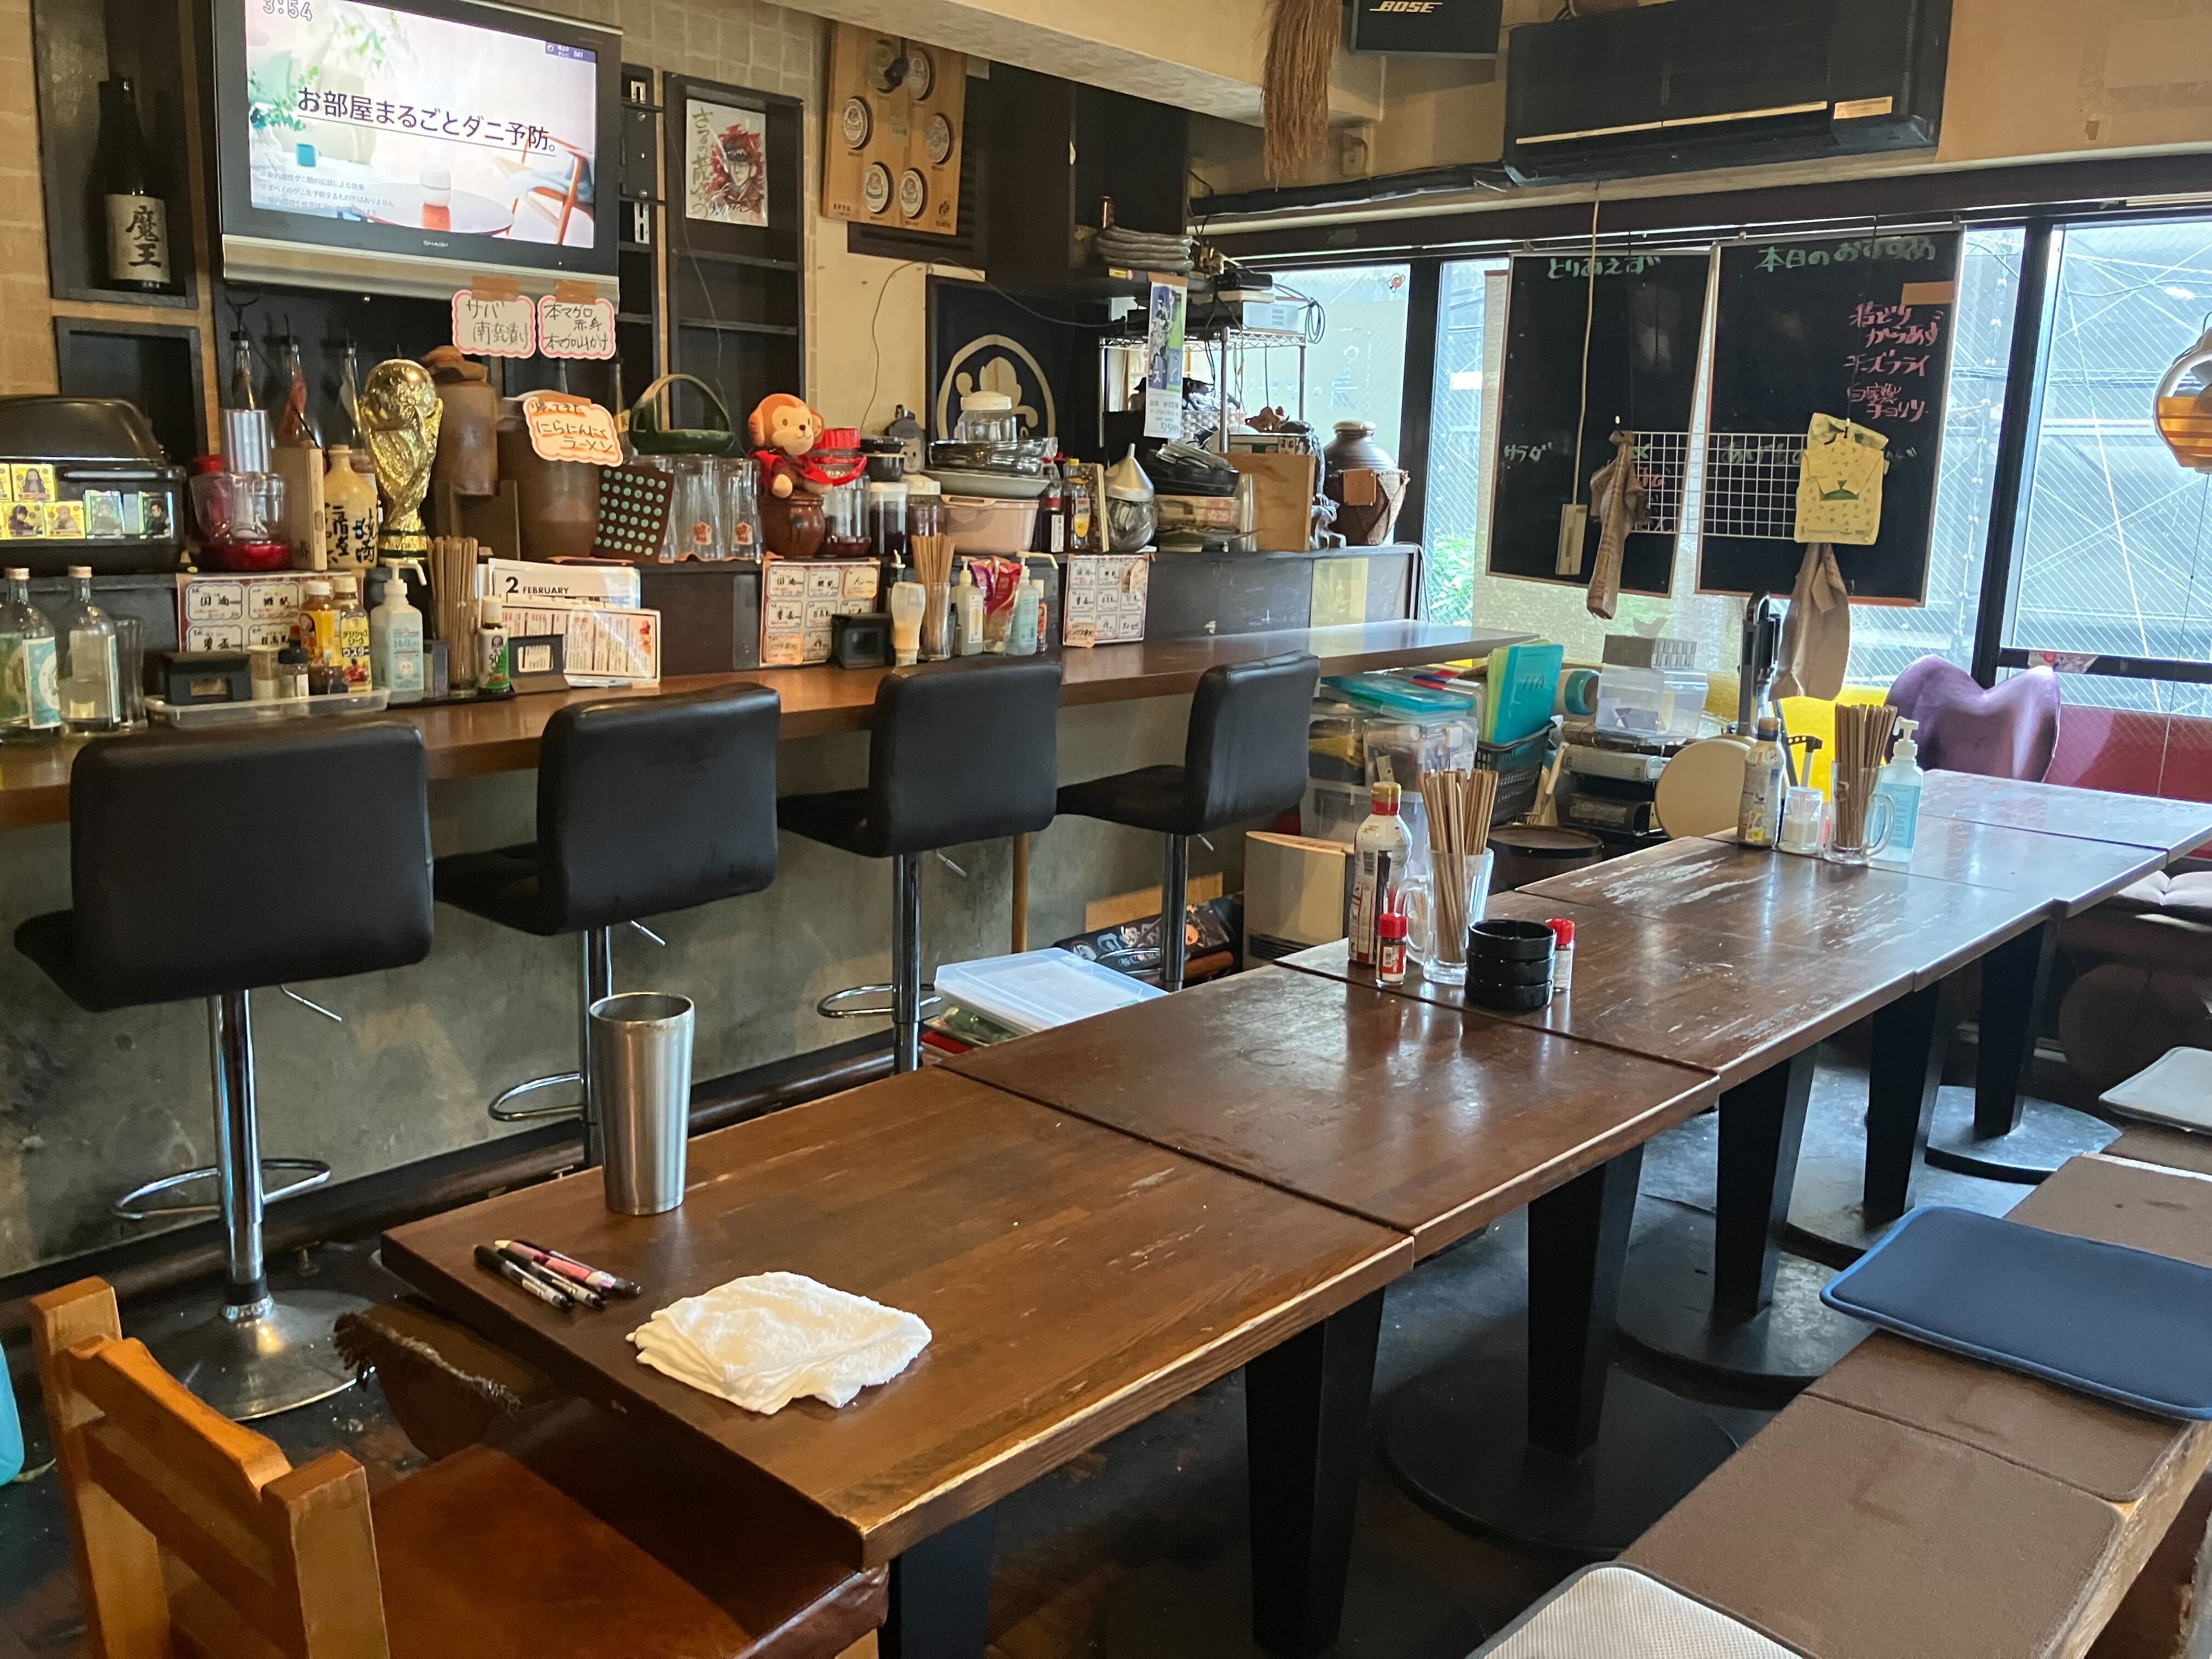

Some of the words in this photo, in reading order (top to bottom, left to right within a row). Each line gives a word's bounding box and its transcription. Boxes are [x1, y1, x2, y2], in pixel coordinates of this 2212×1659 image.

[263, 0, 313, 21] 3:54
[1369, 1, 1443, 13] BOSE
[297, 87, 556, 153] お部屋まるごとダニ予防。
[126, 206, 162, 267] 魔王
[466, 299, 505, 319] サバ
[544, 303, 592, 320] 本マグロ
[536, 420, 609, 440] にらにんにく
[563, 436, 613, 453] ラーメン
[506, 576, 519, 594] 2
[523, 586, 569, 595] FEBRUARY
